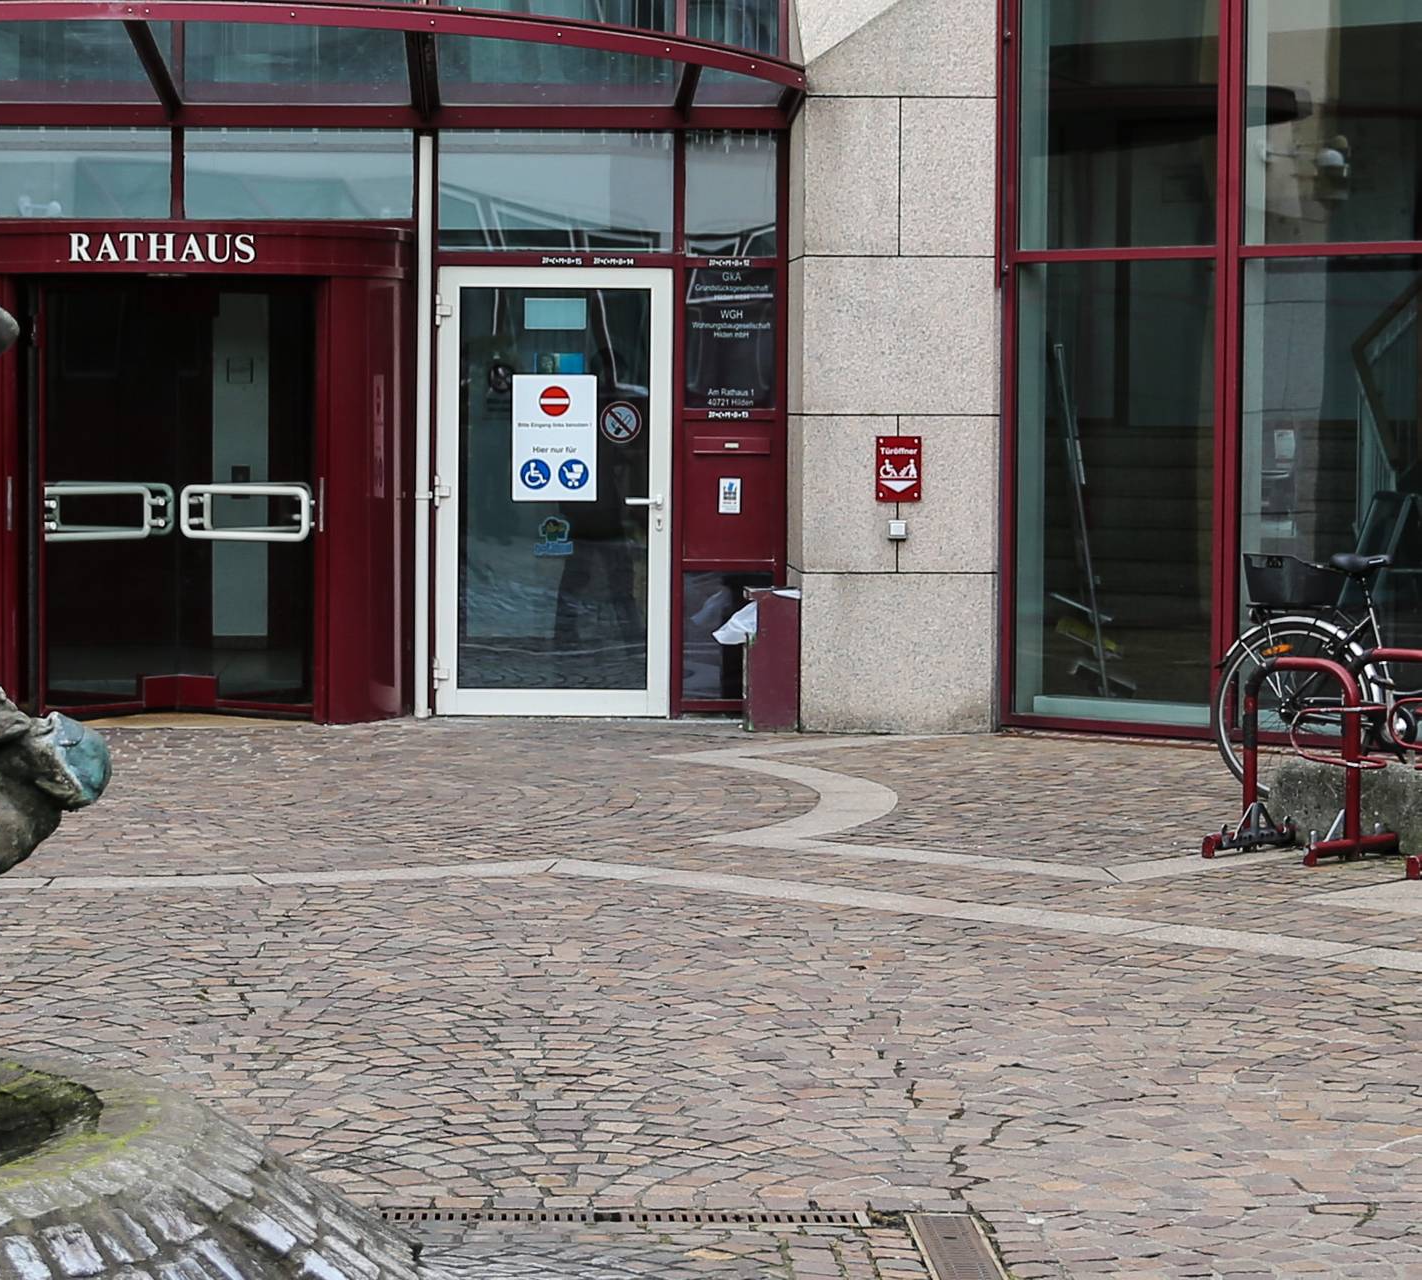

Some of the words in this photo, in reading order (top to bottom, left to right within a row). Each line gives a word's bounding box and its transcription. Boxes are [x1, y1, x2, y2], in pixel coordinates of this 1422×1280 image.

[68, 232, 257, 263] RATHAUS
[720, 309, 744, 319] WGH
[691, 321, 771, 331] Wohnungsbaugesellschaft
[707, 388, 720, 396] Am
[721, 387, 749, 396] Rathaus
[707, 398, 729, 407] 40721
[731, 398, 754, 407] Hilden
[879, 446, 918, 455] Türöffner
